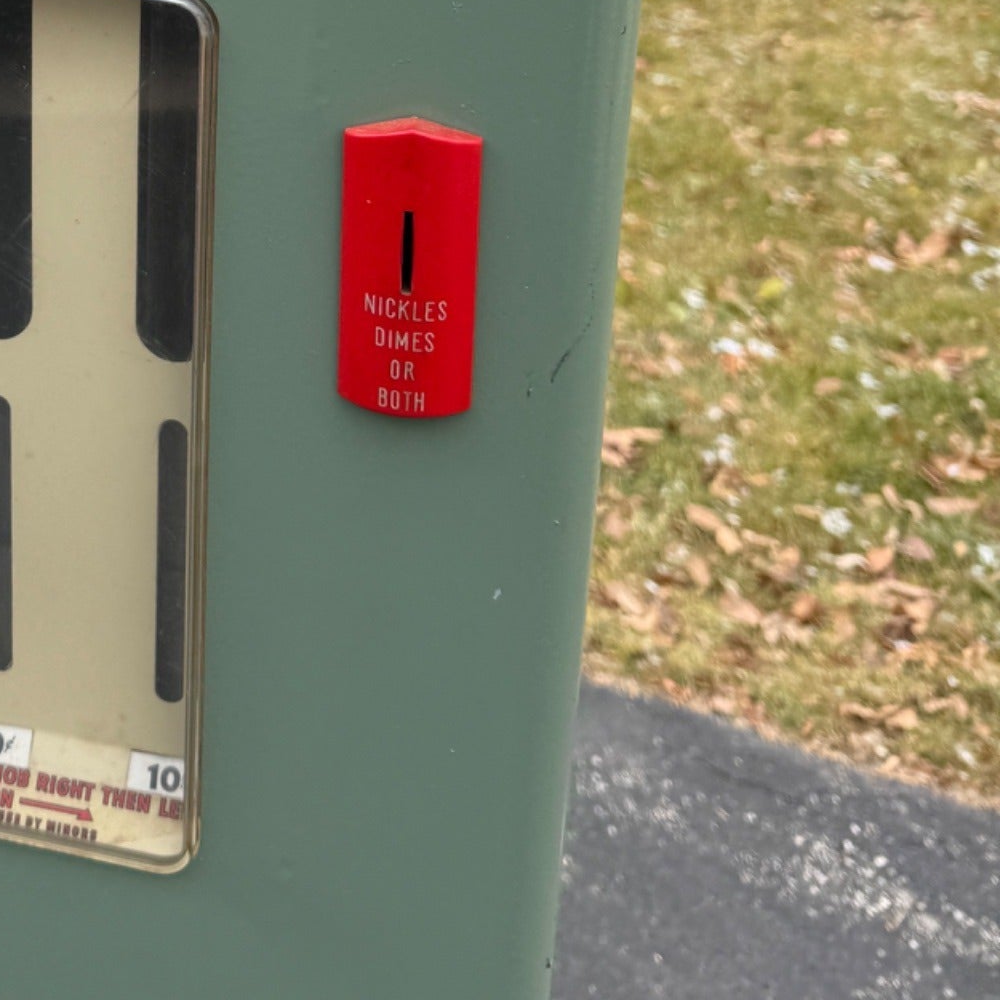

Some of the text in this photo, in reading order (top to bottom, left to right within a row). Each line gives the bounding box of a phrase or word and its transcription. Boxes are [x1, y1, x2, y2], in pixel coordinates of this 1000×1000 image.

[364, 293, 448, 322] NICKLES
[375, 326, 435, 353] DIMES
[390, 359, 415, 380] OR
[378, 387, 425, 412] BOTH
[148, 763, 183, 792] 10
[36, 772, 96, 802] RIGHT
[101, 785, 152, 814] THEN
